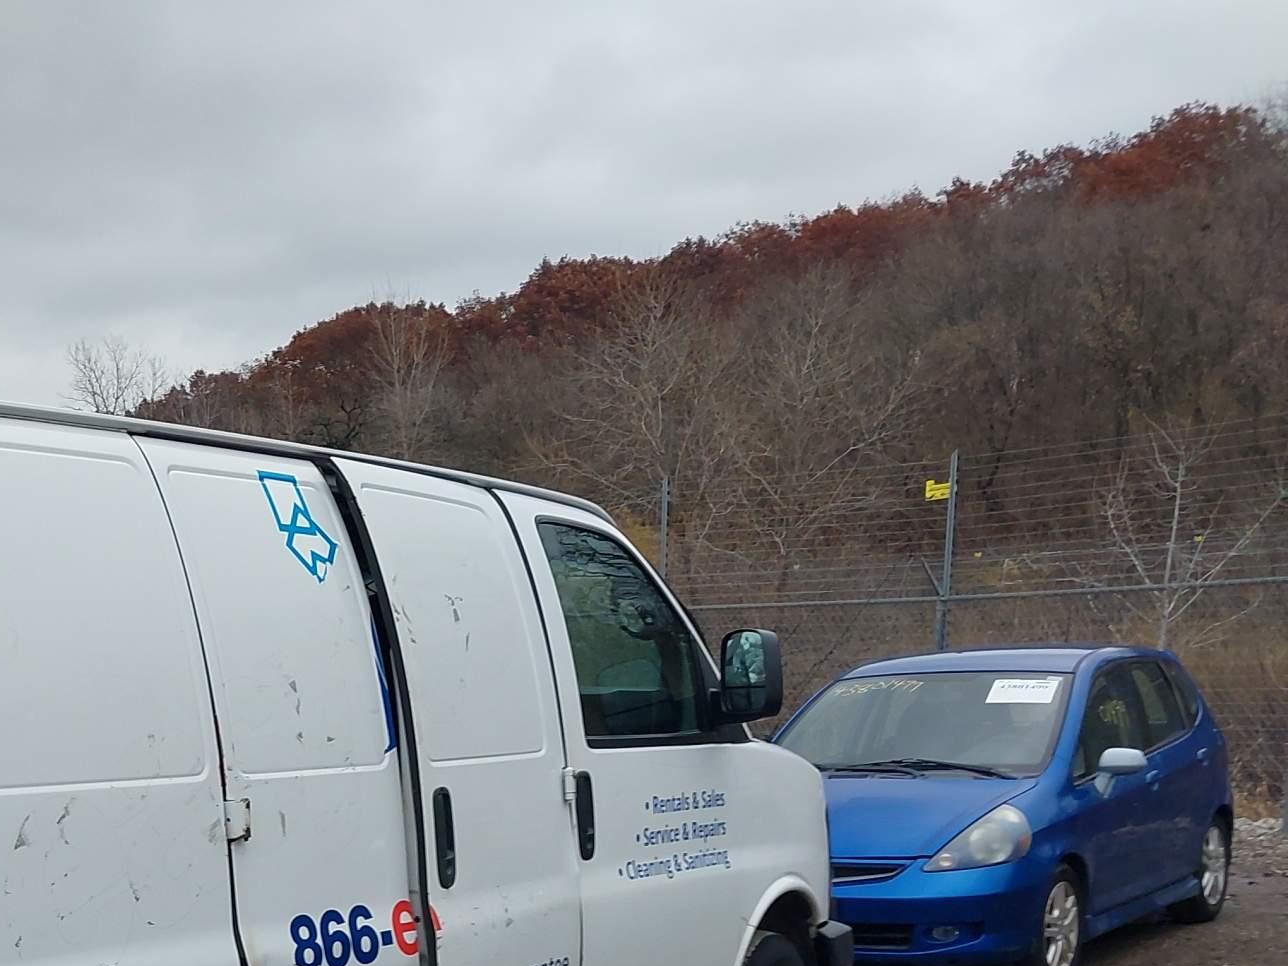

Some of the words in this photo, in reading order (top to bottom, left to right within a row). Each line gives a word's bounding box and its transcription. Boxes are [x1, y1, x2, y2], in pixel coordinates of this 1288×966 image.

[652, 792, 690, 814] Rentals
[691, 791, 700, 809] &
[701, 788, 726, 808] Sales
[643, 824, 680, 847] Service
[681, 822, 690, 840] &
[691, 818, 727, 843] Repairs
[625, 856, 674, 879] Cleaning
[672, 854, 682, 872] &
[683, 848, 732, 869] Sanitizing
